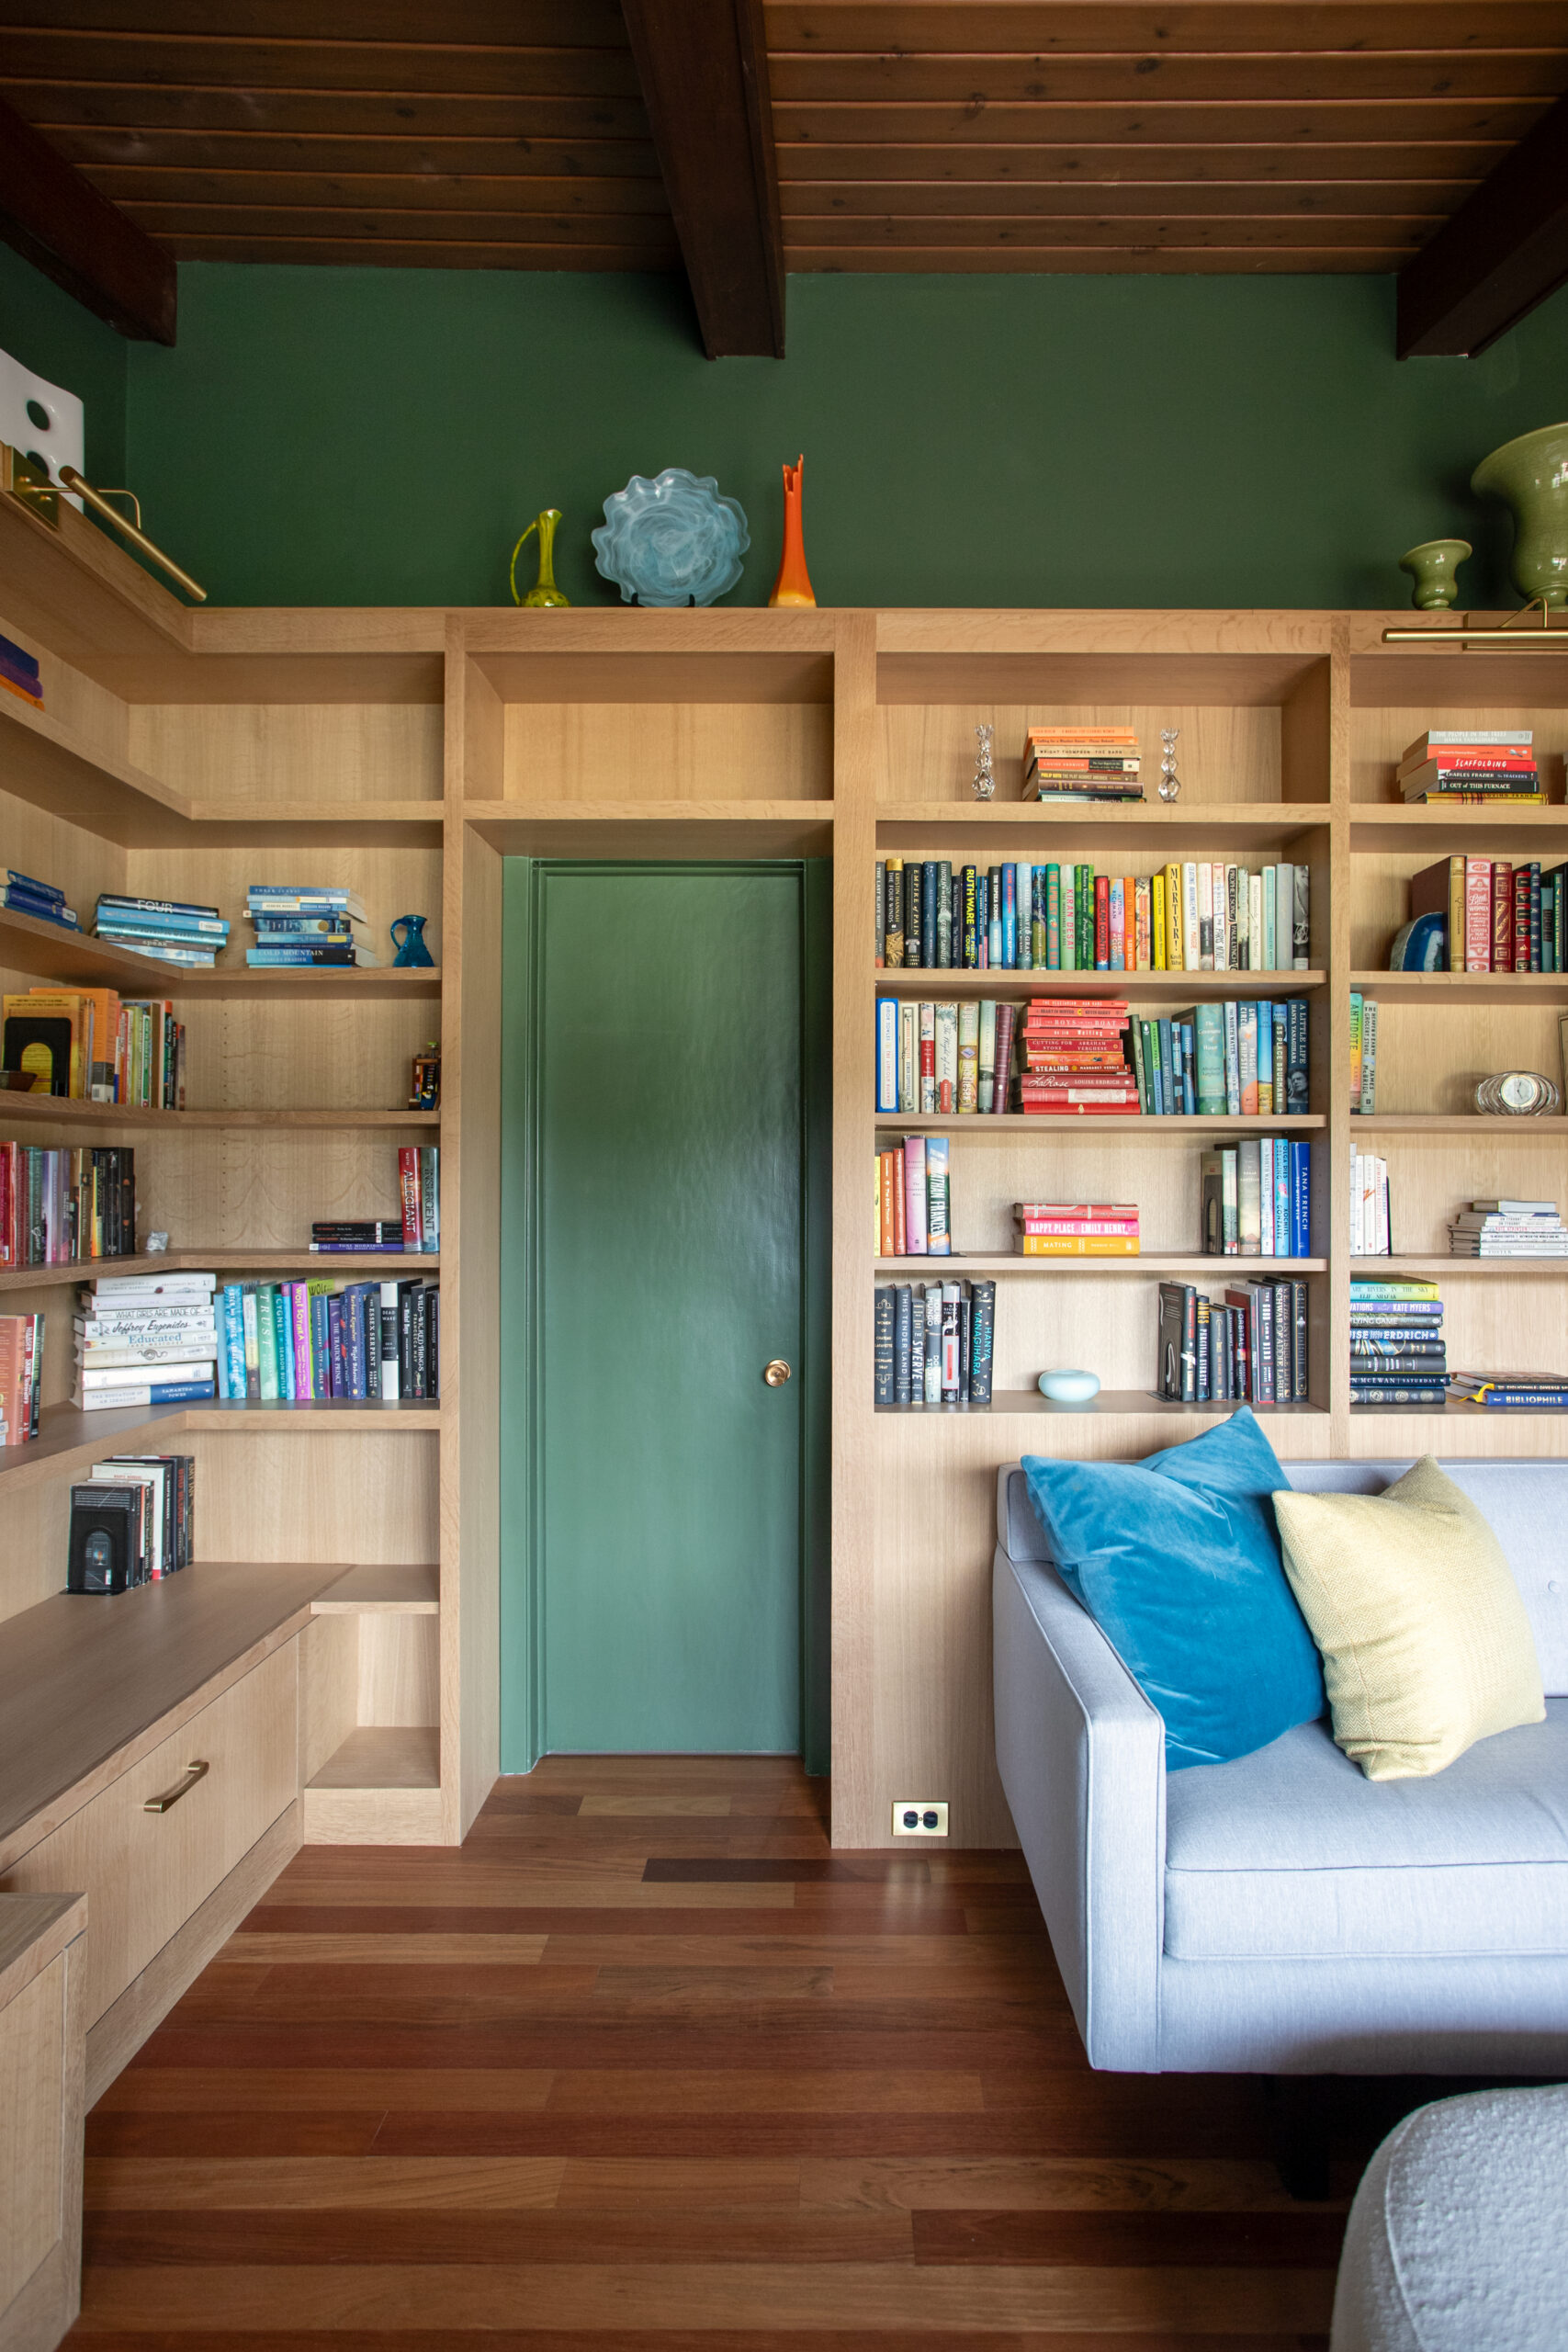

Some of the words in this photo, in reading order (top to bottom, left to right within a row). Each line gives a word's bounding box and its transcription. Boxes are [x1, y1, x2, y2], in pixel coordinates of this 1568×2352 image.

[1455, 759, 1506, 767] SCAFFOLDING
[966, 869, 975, 895] RUTH
[138, 899, 174, 913] FOUR
[966, 897, 975, 924] WARE
[1350, 1004, 1359, 1050] ANTIDOTE
[1029, 1076, 1069, 1088] LaRose
[930, 1158, 945, 1198] JONATHAN
[404, 1170, 415, 1232] ALLEGIANT
[424, 1169, 434, 1231] INSURGENT
[930, 1201, 946, 1238] FRANZEN
[1031, 1224, 1052, 1233] HAPPY
[1055, 1224, 1075, 1233] PLACE
[1081, 1224, 1103, 1234] EMILY
[1104, 1224, 1128, 1235] HENRY
[260, 1294, 270, 1348] TRUST
[1198, 1302, 1209, 1324] JAMES
[112, 1322, 145, 1334] Jeffrey
[147, 1319, 188, 1334] Eugenides
[129, 1333, 182, 1344] Educated
[973, 1311, 981, 1374] YANAGIHARA
[912, 1340, 923, 1380] SWERVE
[1199, 1359, 1207, 1385] EVERETT
